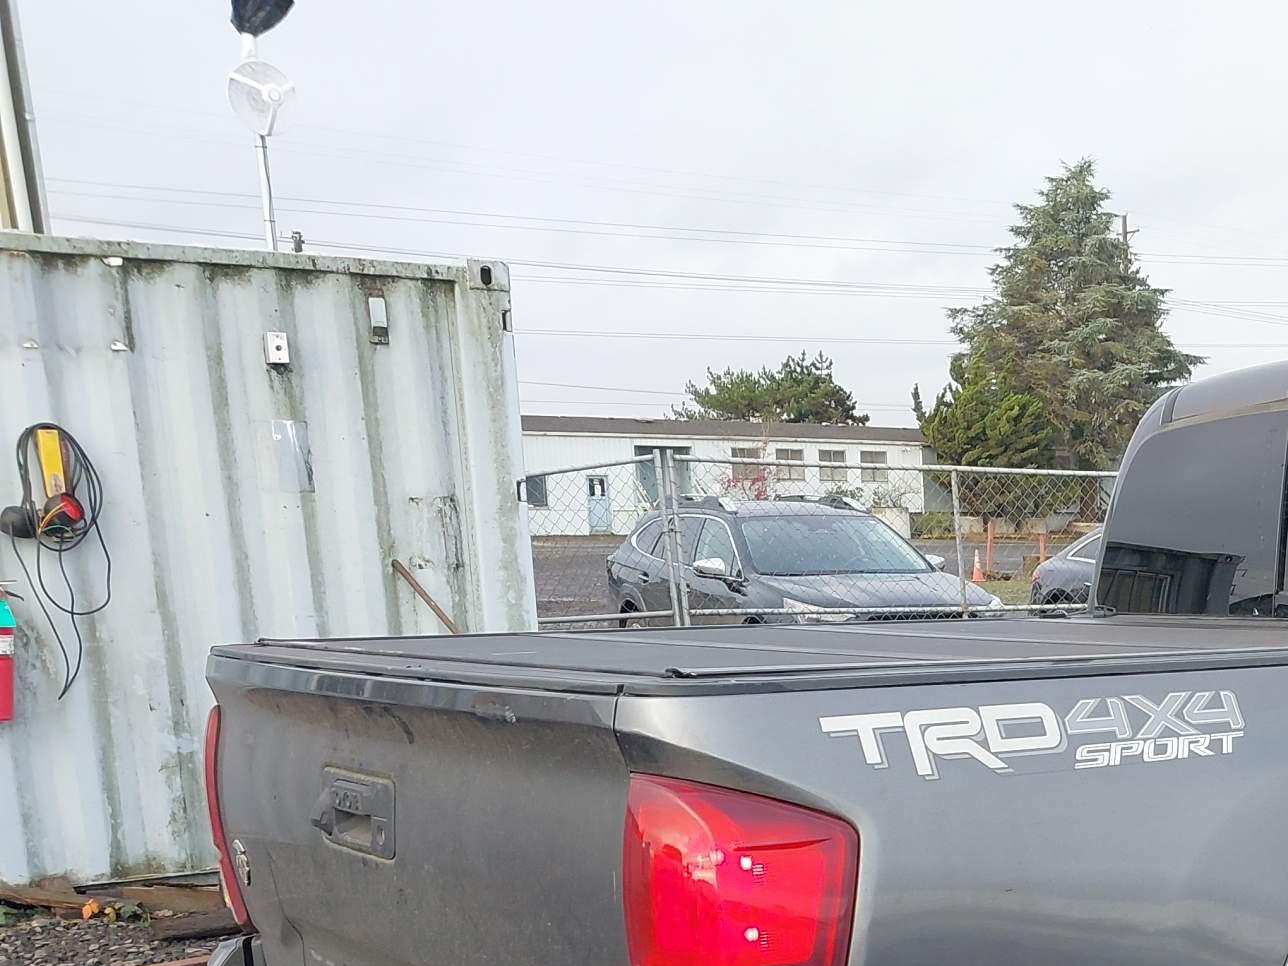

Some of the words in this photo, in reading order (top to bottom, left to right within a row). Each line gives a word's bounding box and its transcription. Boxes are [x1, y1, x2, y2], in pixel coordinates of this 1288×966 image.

[818, 702, 1067, 779] TRD
[1064, 690, 1246, 737] 4X4
[1074, 732, 1245, 769] SPORT
